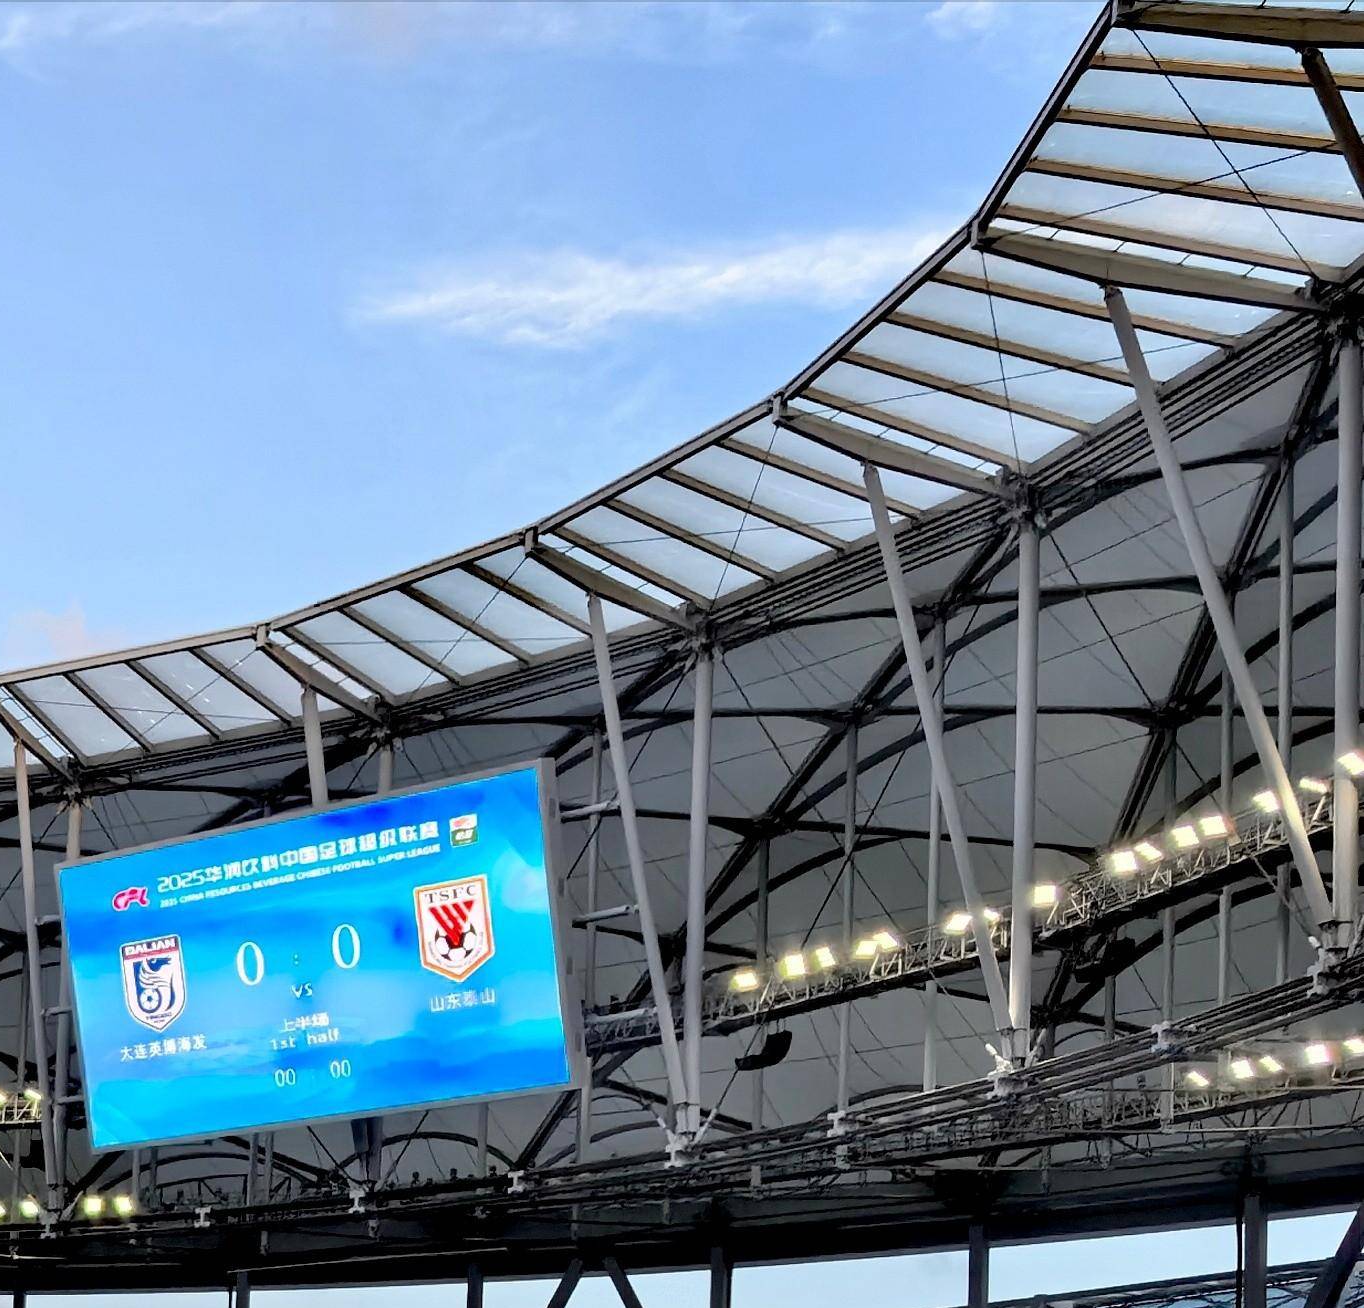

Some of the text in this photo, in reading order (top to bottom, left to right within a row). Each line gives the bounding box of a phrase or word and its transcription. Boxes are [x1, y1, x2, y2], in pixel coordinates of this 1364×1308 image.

[333, 858, 375, 873] FOOTBALL
[424, 885, 476, 904] TSFC
[125, 938, 176, 956] DALIAN
[236, 941, 265, 986] 0
[330, 923, 361, 970] 0
[431, 988, 496, 1014] 山东泰山
[120, 1033, 207, 1061] 大连英博海发
